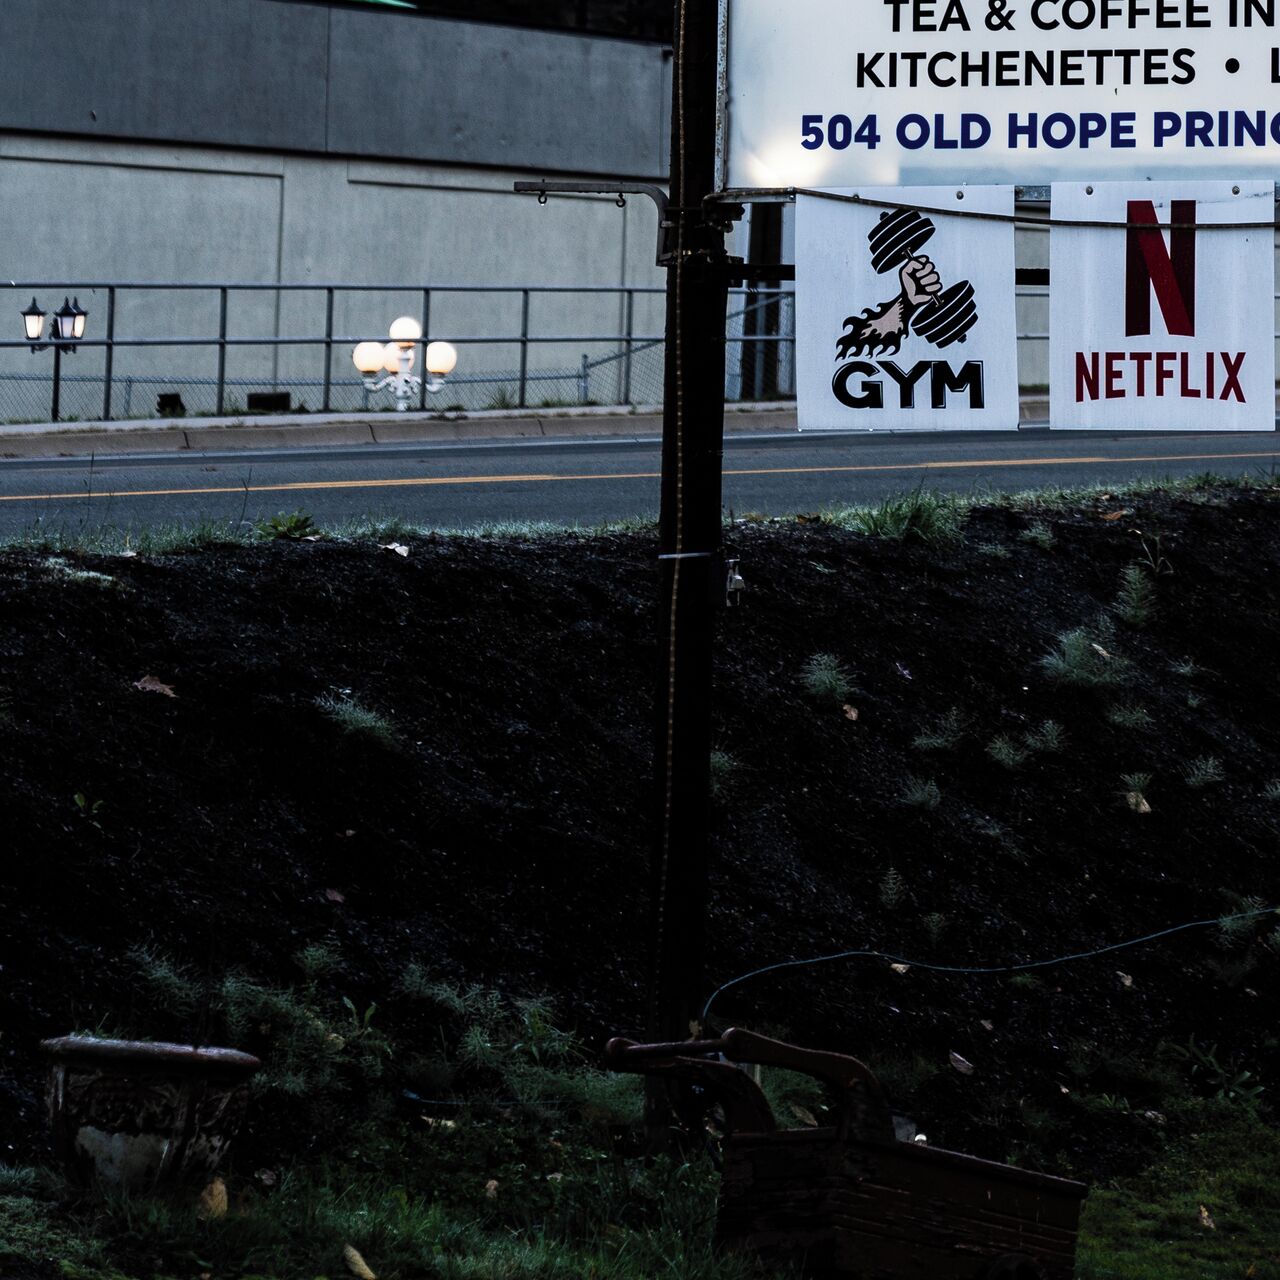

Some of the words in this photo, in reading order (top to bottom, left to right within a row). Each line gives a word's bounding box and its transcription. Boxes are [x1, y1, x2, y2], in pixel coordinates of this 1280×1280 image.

[856, 47, 1196, 88] KITCHENETTES
[800, 114, 881, 151] 504
[895, 113, 992, 150] OLD
[1008, 111, 1137, 149] HOPE
[831, 359, 985, 410] GYM
[1075, 351, 1247, 403] NETFLIX
